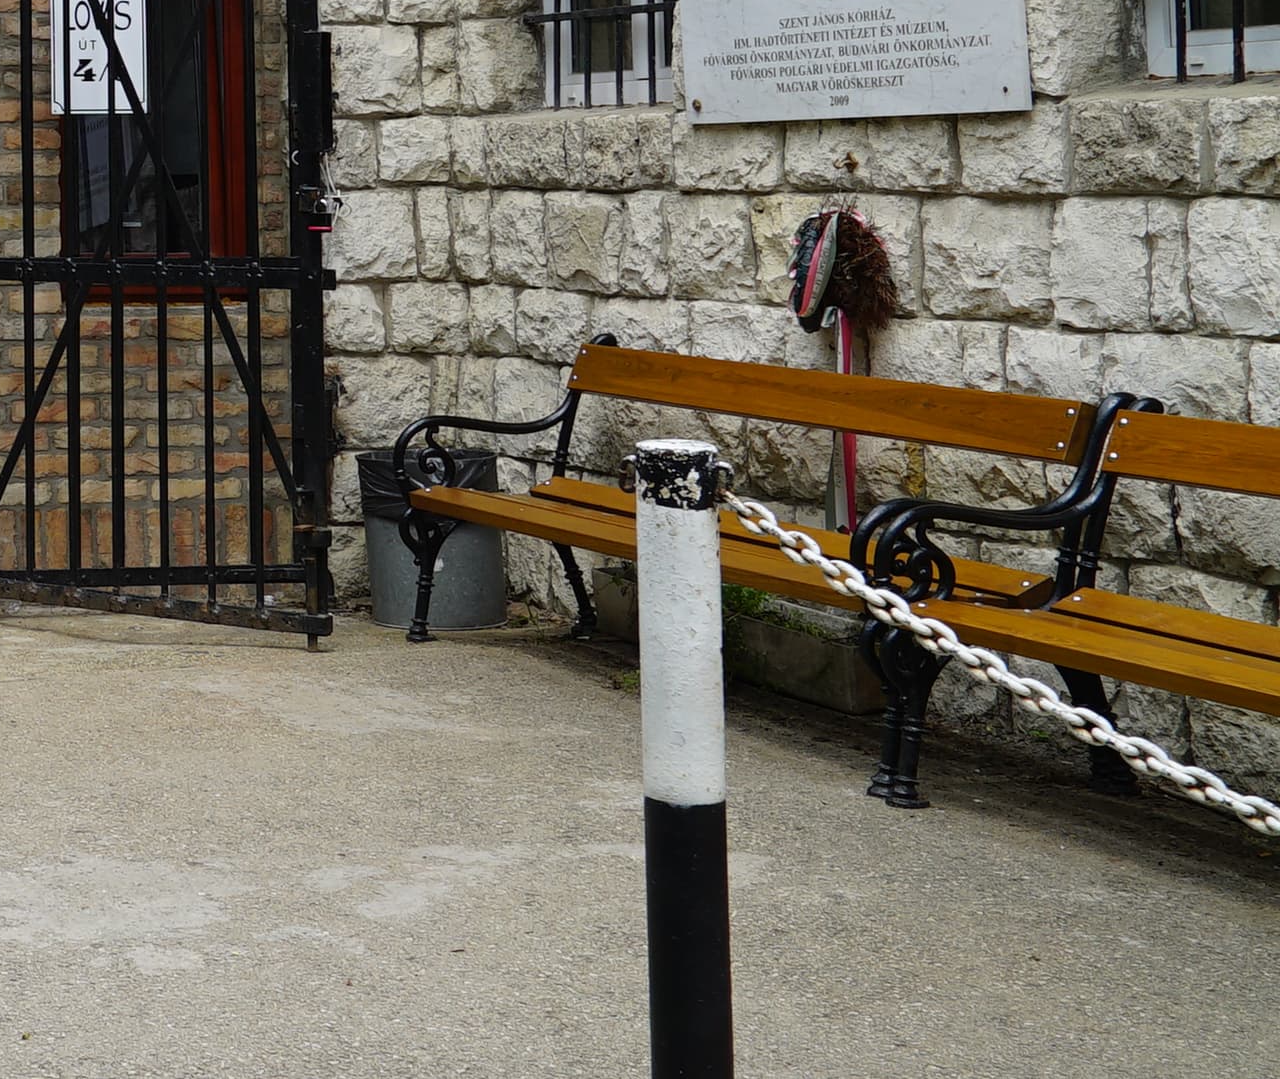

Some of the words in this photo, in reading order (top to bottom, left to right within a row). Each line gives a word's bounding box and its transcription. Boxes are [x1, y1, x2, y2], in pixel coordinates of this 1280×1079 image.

[779, 16, 809, 30] SZENT
[812, 11, 845, 27] JÁNOS
[832, 24, 877, 41] INTÉZET
[880, 22, 893, 37] ÉS
[838, 40, 890, 57] BUDAVÁRI
[73, 58, 122, 82] 4/
[779, 61, 823, 77] POLGÁRI
[826, 59, 873, 74] VÉDELMI
[876, 51, 960, 71] IGAZGATÓSÁG,
[776, 81, 819, 93] MAGYAR
[820, 74, 905, 91] VÖRÖSKERESZT
[830, 95, 850, 107] 2009
